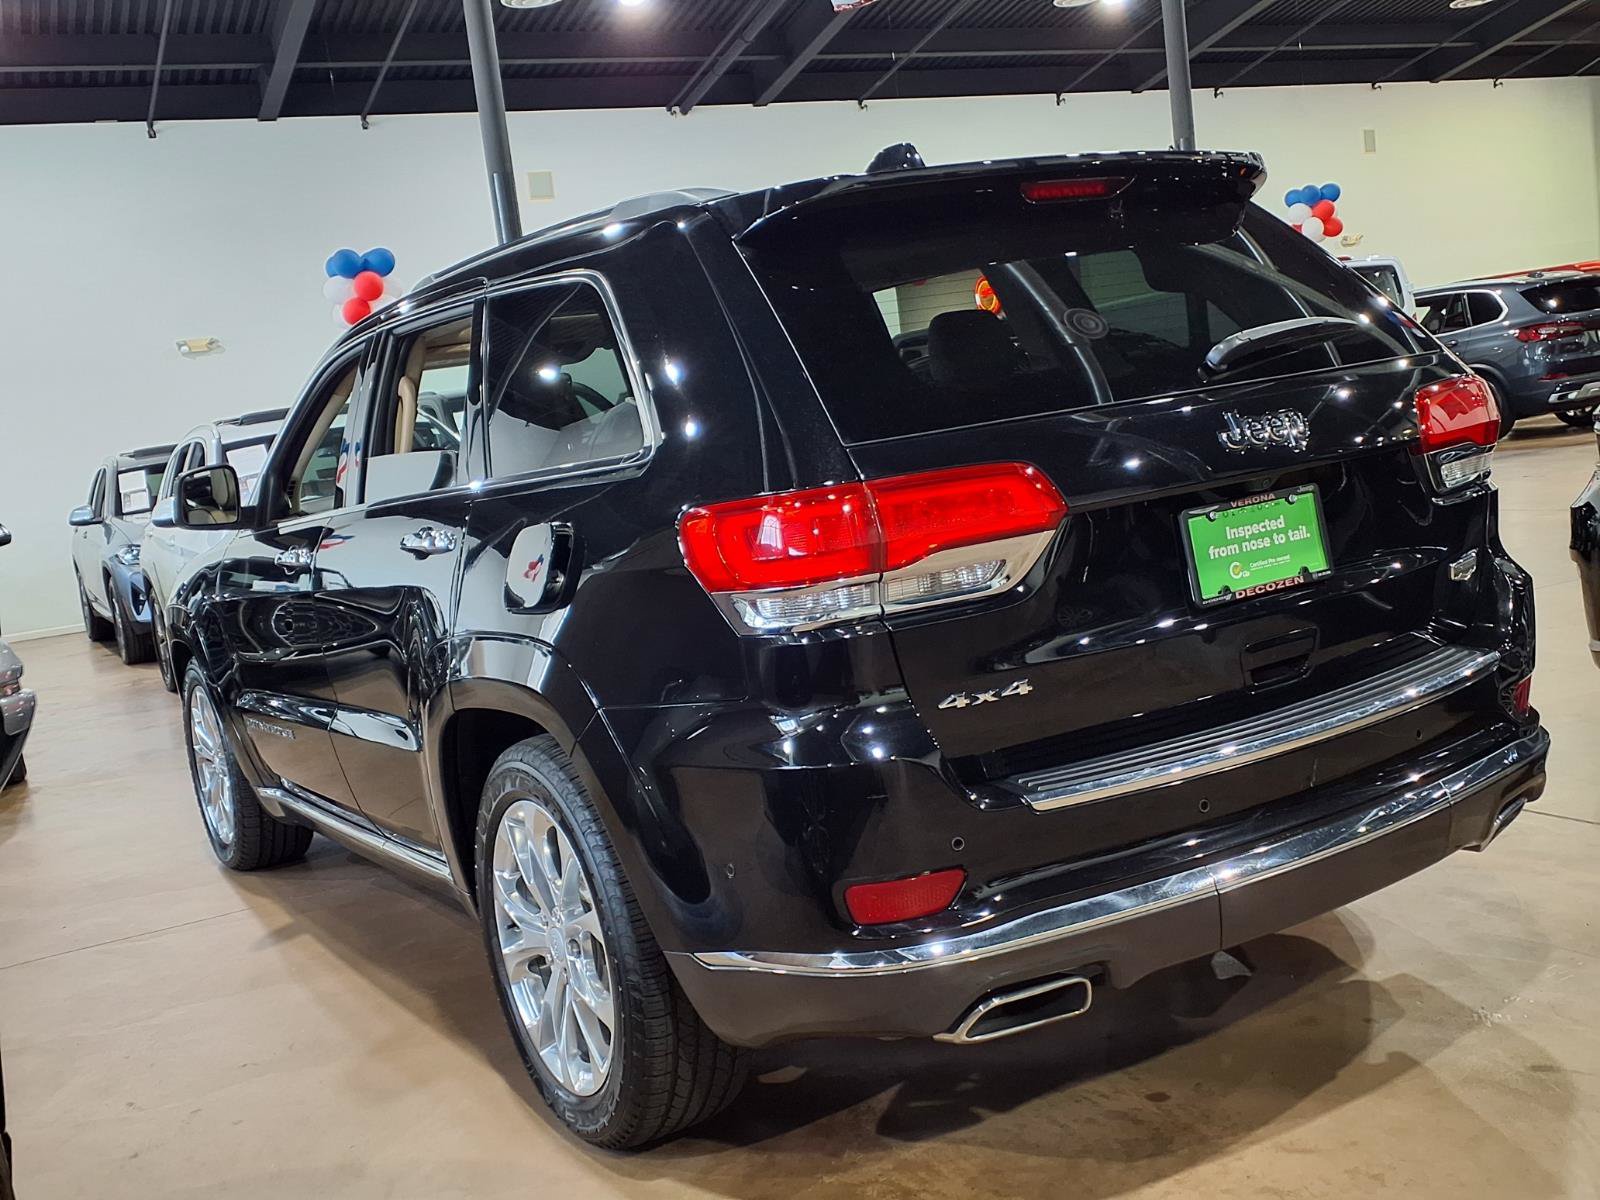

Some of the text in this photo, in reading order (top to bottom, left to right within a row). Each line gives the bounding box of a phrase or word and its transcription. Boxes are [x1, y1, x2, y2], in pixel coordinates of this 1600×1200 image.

[1217, 408, 1310, 454] Jeep
[1230, 493, 1276, 508] VERONA
[1226, 514, 1286, 540] Inspected
[1208, 525, 1311, 560] from nose to tail.
[1235, 575, 1305, 599] DECOZEN
